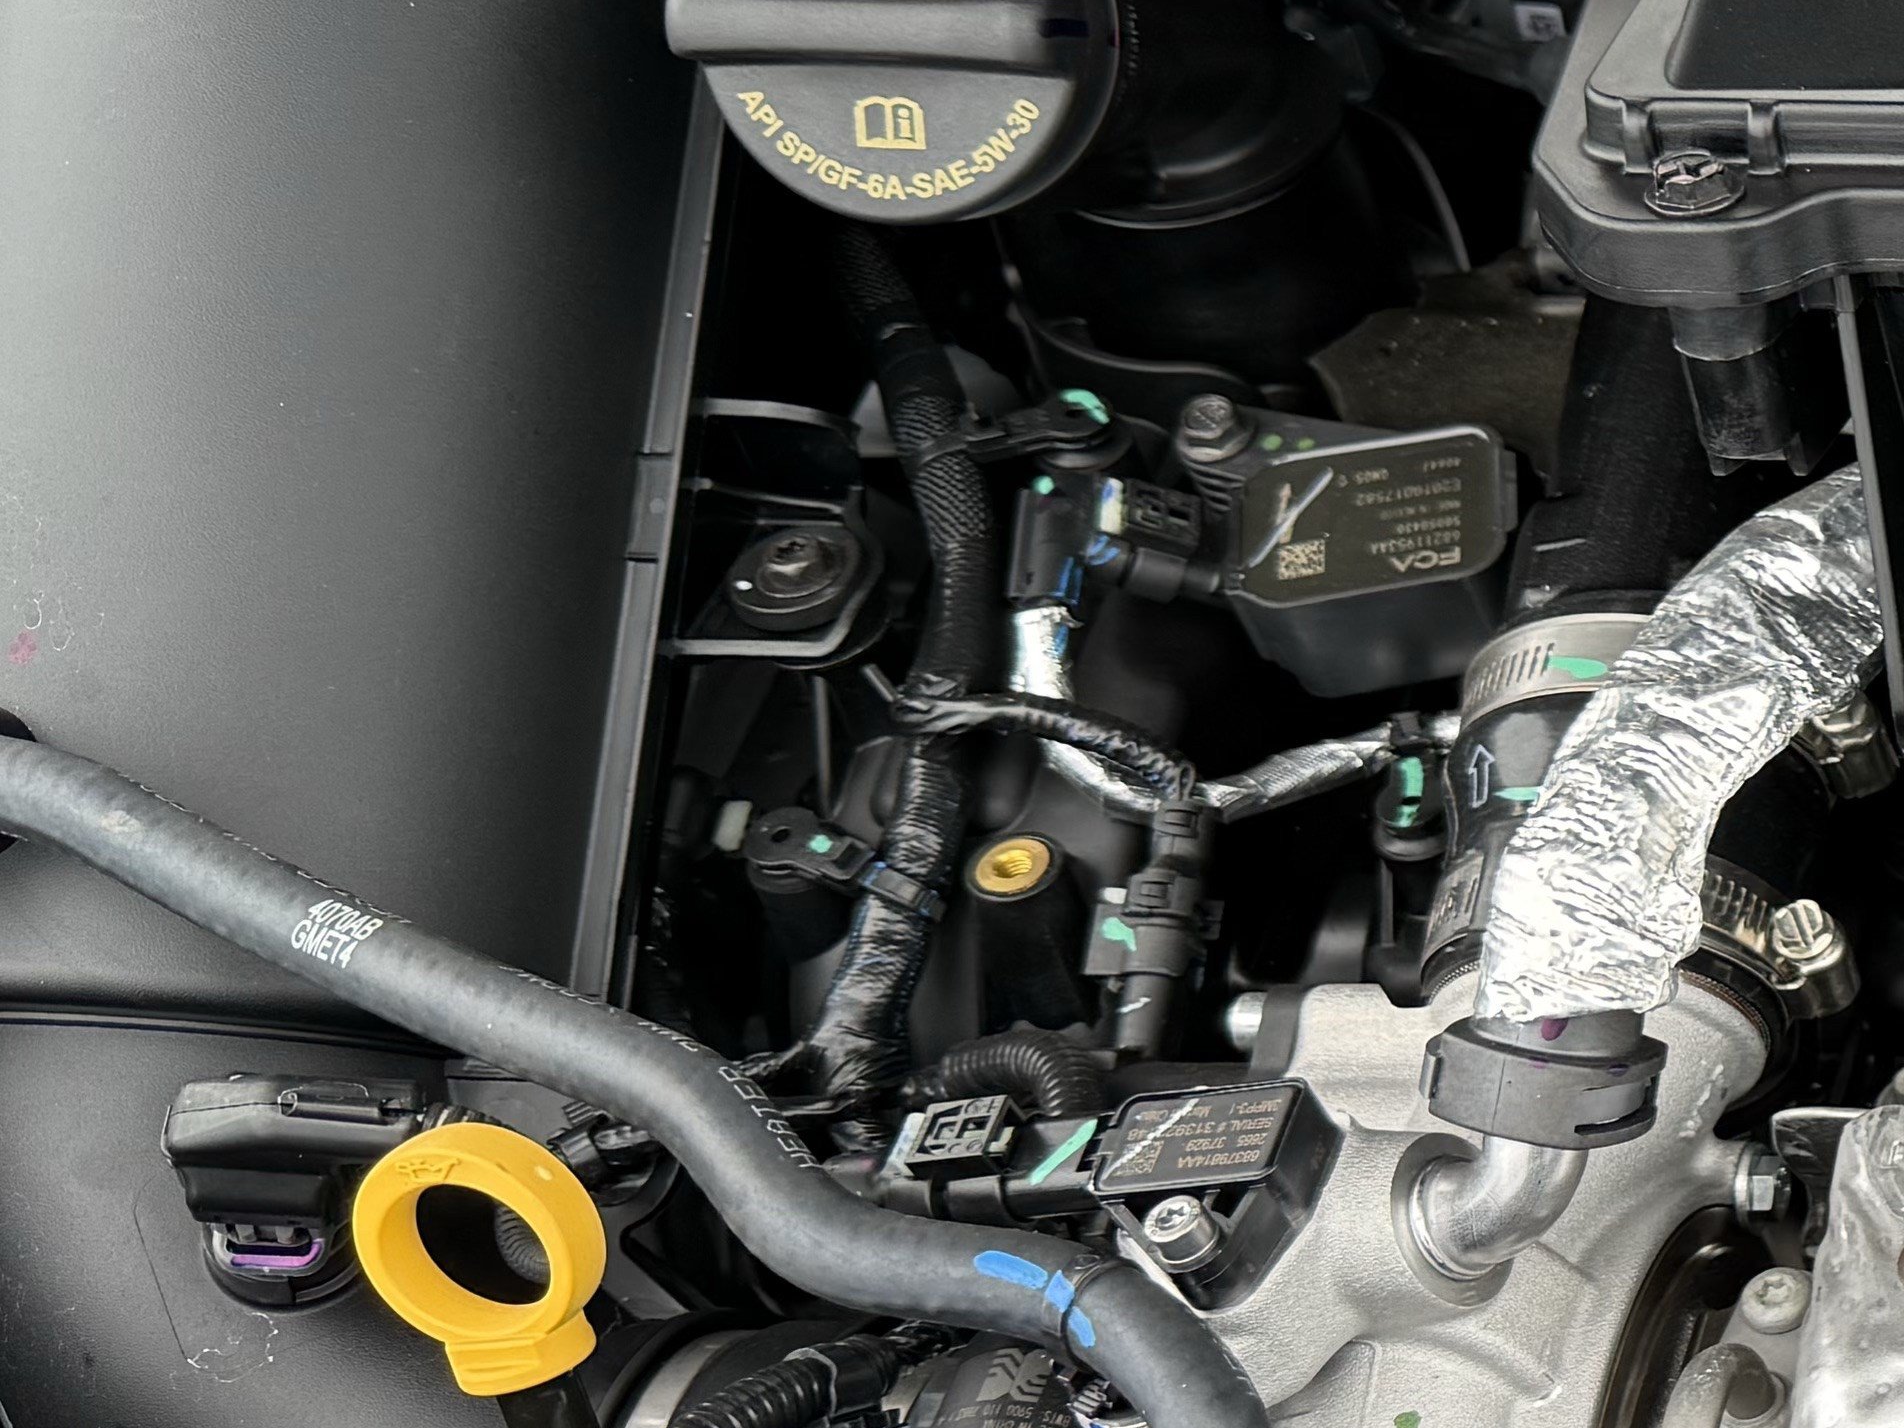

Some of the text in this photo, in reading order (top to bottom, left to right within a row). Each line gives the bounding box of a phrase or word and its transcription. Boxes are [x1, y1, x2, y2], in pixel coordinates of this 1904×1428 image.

[737, 91, 784, 138] API
[1389, 547, 1463, 574] FCA
[308, 899, 384, 941] 4070AB
[291, 920, 359, 969] GMET4
[718, 1065, 820, 1169] HEATER
[1230, 1117, 1274, 1131] SERIAL
